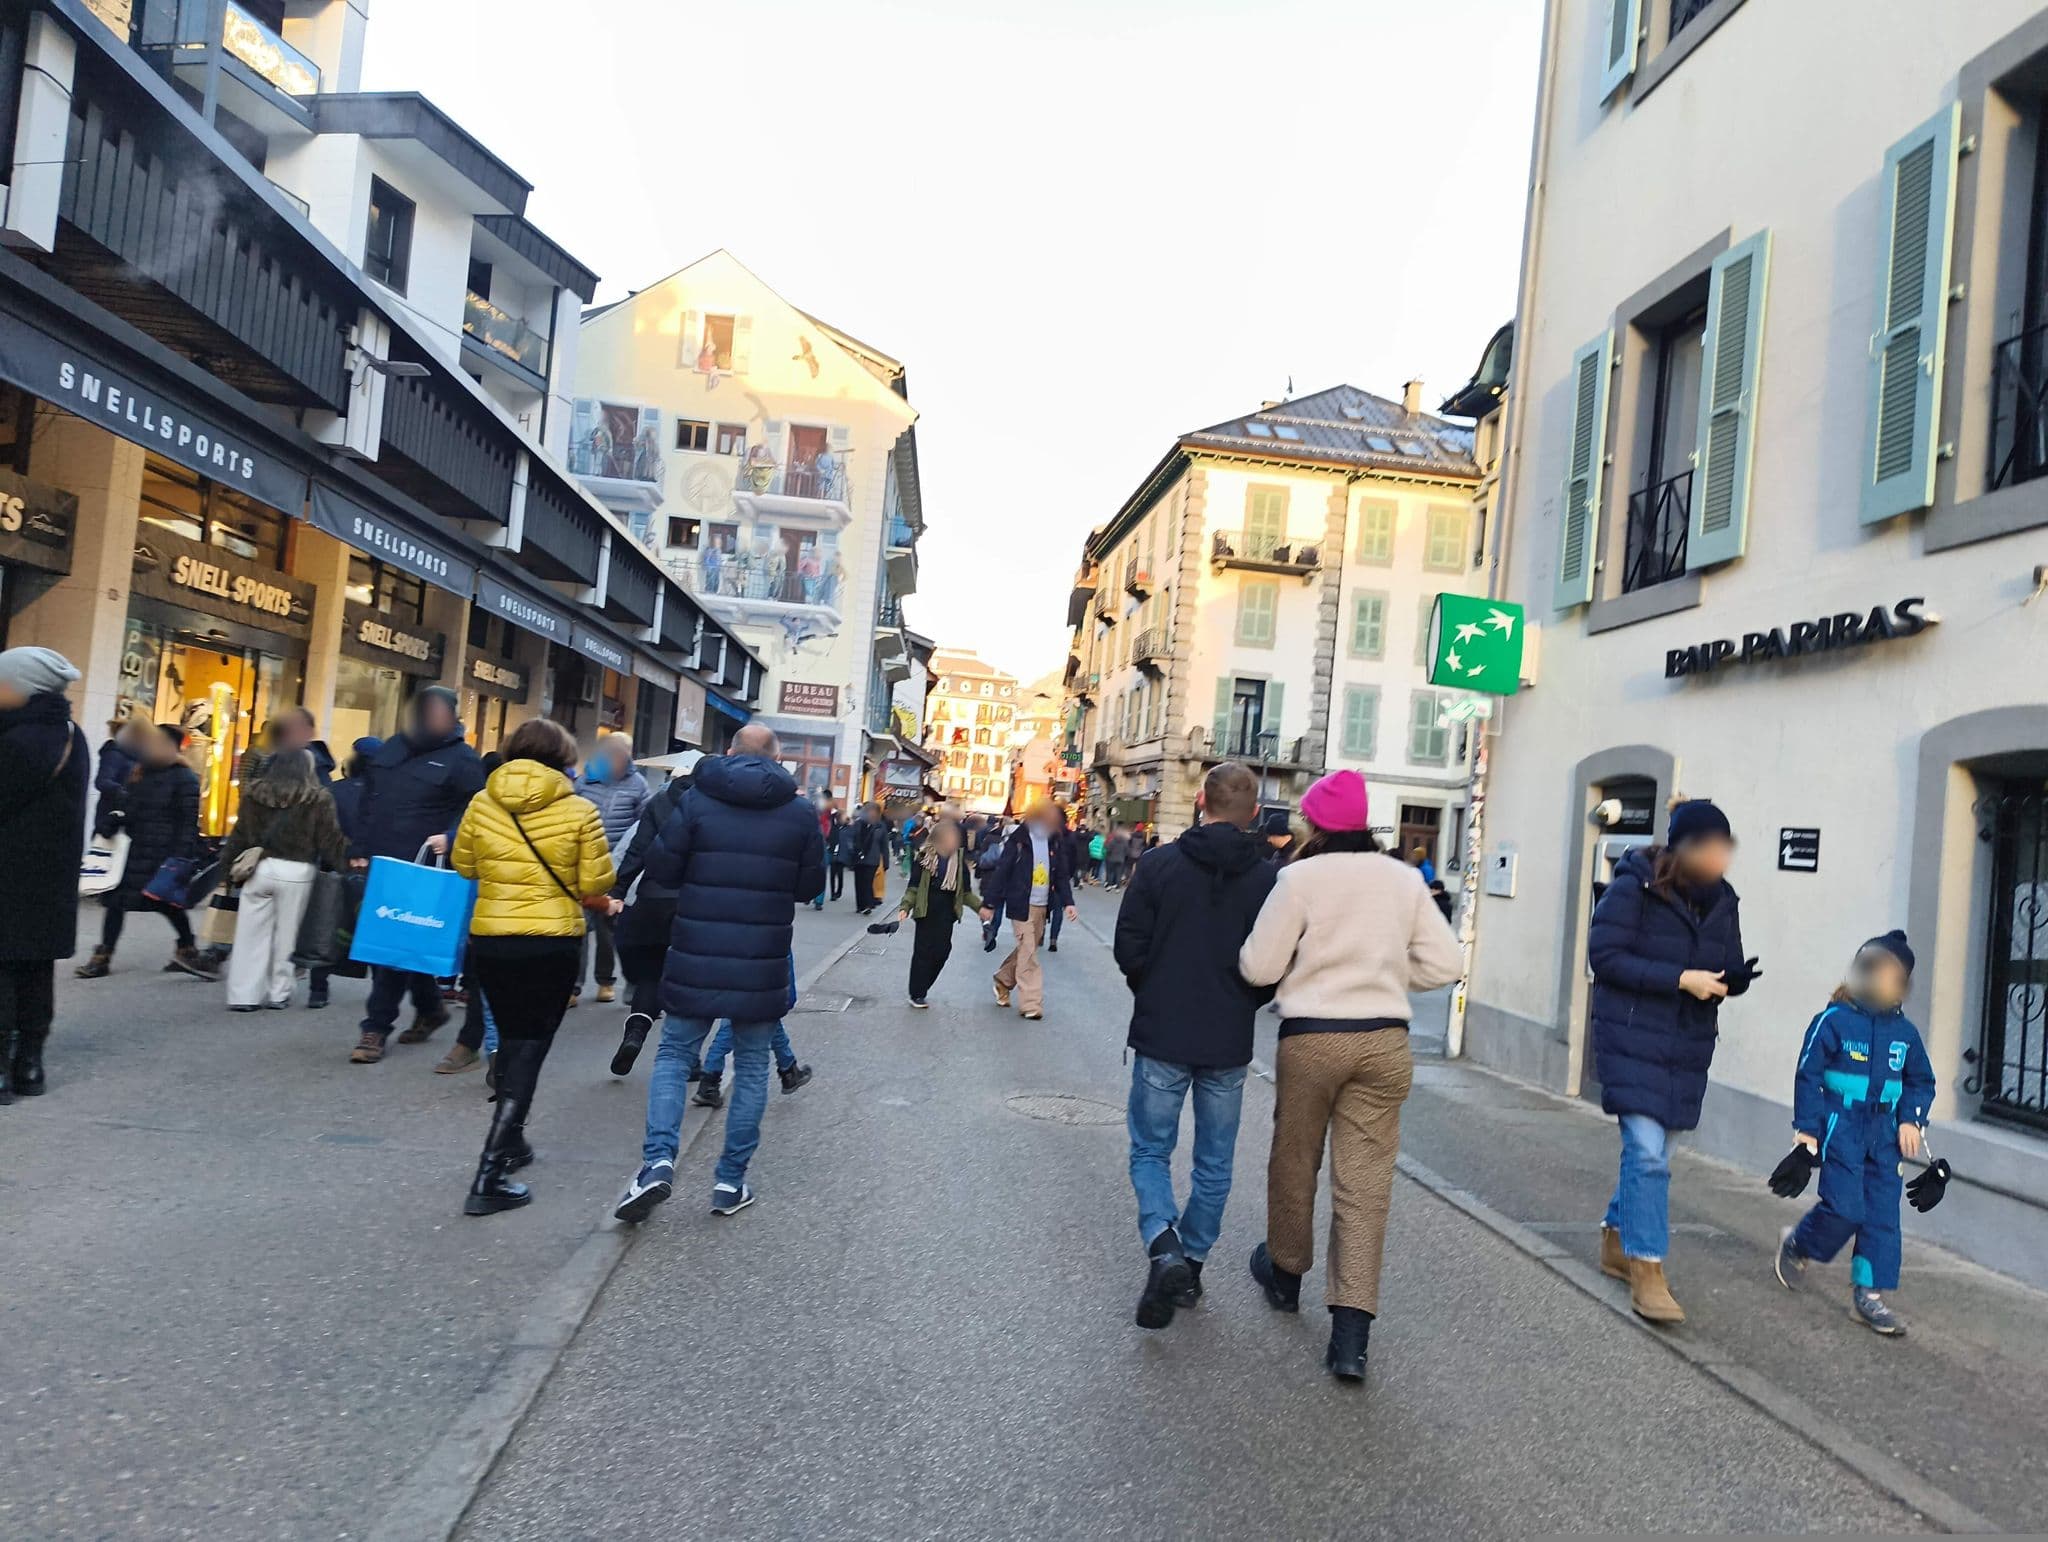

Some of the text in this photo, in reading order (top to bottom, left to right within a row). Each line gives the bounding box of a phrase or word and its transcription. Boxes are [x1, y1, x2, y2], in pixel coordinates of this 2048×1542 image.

[59, 362, 254, 479] SNELLSPORTS
[353, 517, 448, 577] SNELLSPORTS
[174, 555, 292, 616] SNELL SPORTS
[500, 594, 556, 632] SNELLSPORTS
[359, 620, 393, 650] SNELL
[1665, 596, 1926, 679] BNP PARIBAS
[785, 683, 834, 696] BUREAU
